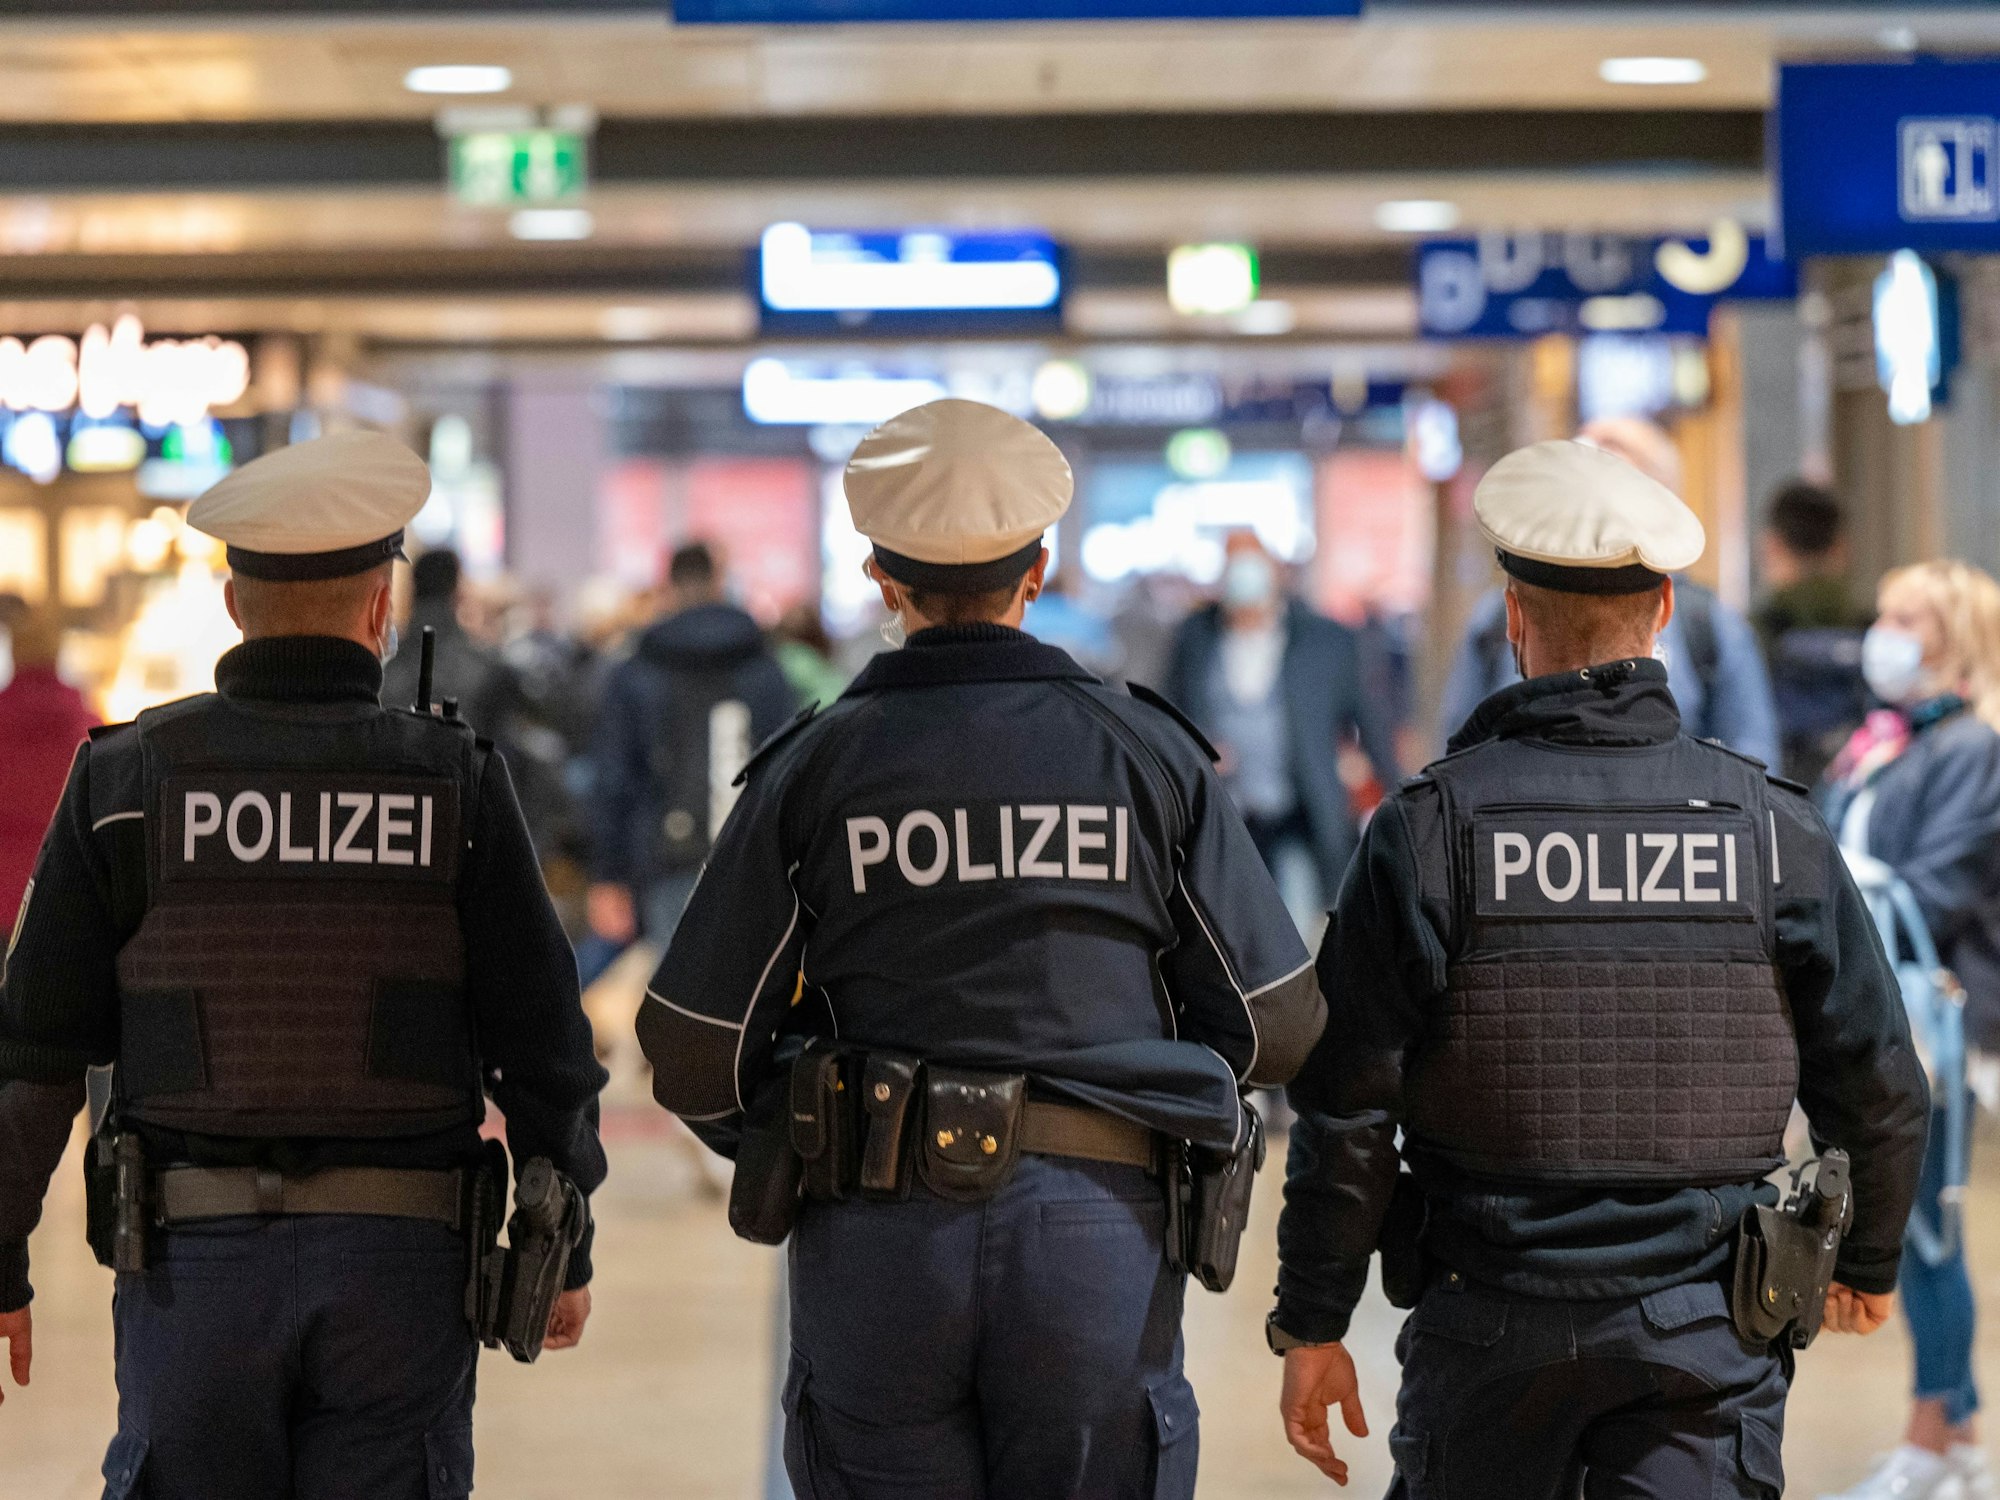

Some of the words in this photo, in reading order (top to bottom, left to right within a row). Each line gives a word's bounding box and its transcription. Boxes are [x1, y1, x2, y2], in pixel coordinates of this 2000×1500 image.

[184, 790, 433, 867] POLIZEI
[846, 804, 1128, 894] POLIZEI
[1493, 831, 1737, 902] POLIZEI
